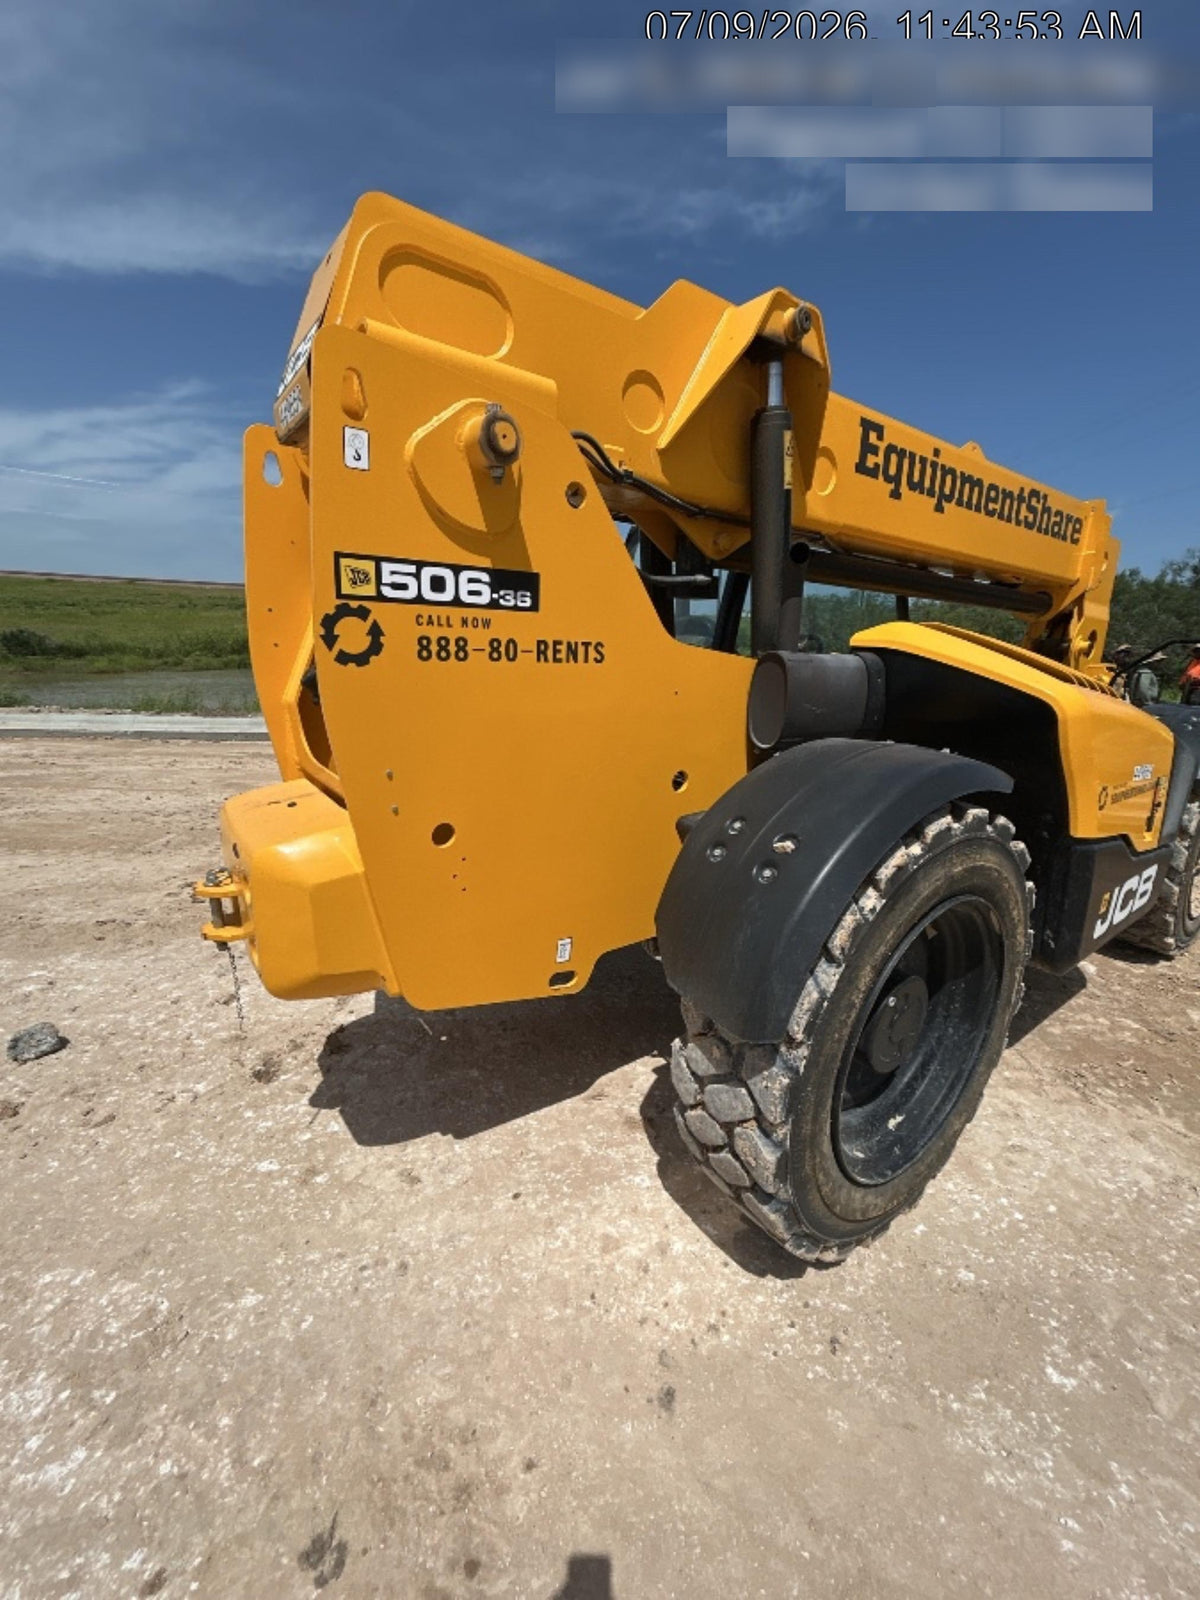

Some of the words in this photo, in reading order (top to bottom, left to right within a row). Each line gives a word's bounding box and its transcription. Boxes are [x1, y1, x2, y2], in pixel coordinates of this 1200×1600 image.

[855, 416, 1084, 546] EquipmentShare
[379, 561, 533, 608] 506-36
[415, 613, 453, 628] CALL
[461, 616, 492, 629] NOW
[416, 635, 606, 664] 888-80-RENTS
[1093, 863, 1159, 940] JCB
